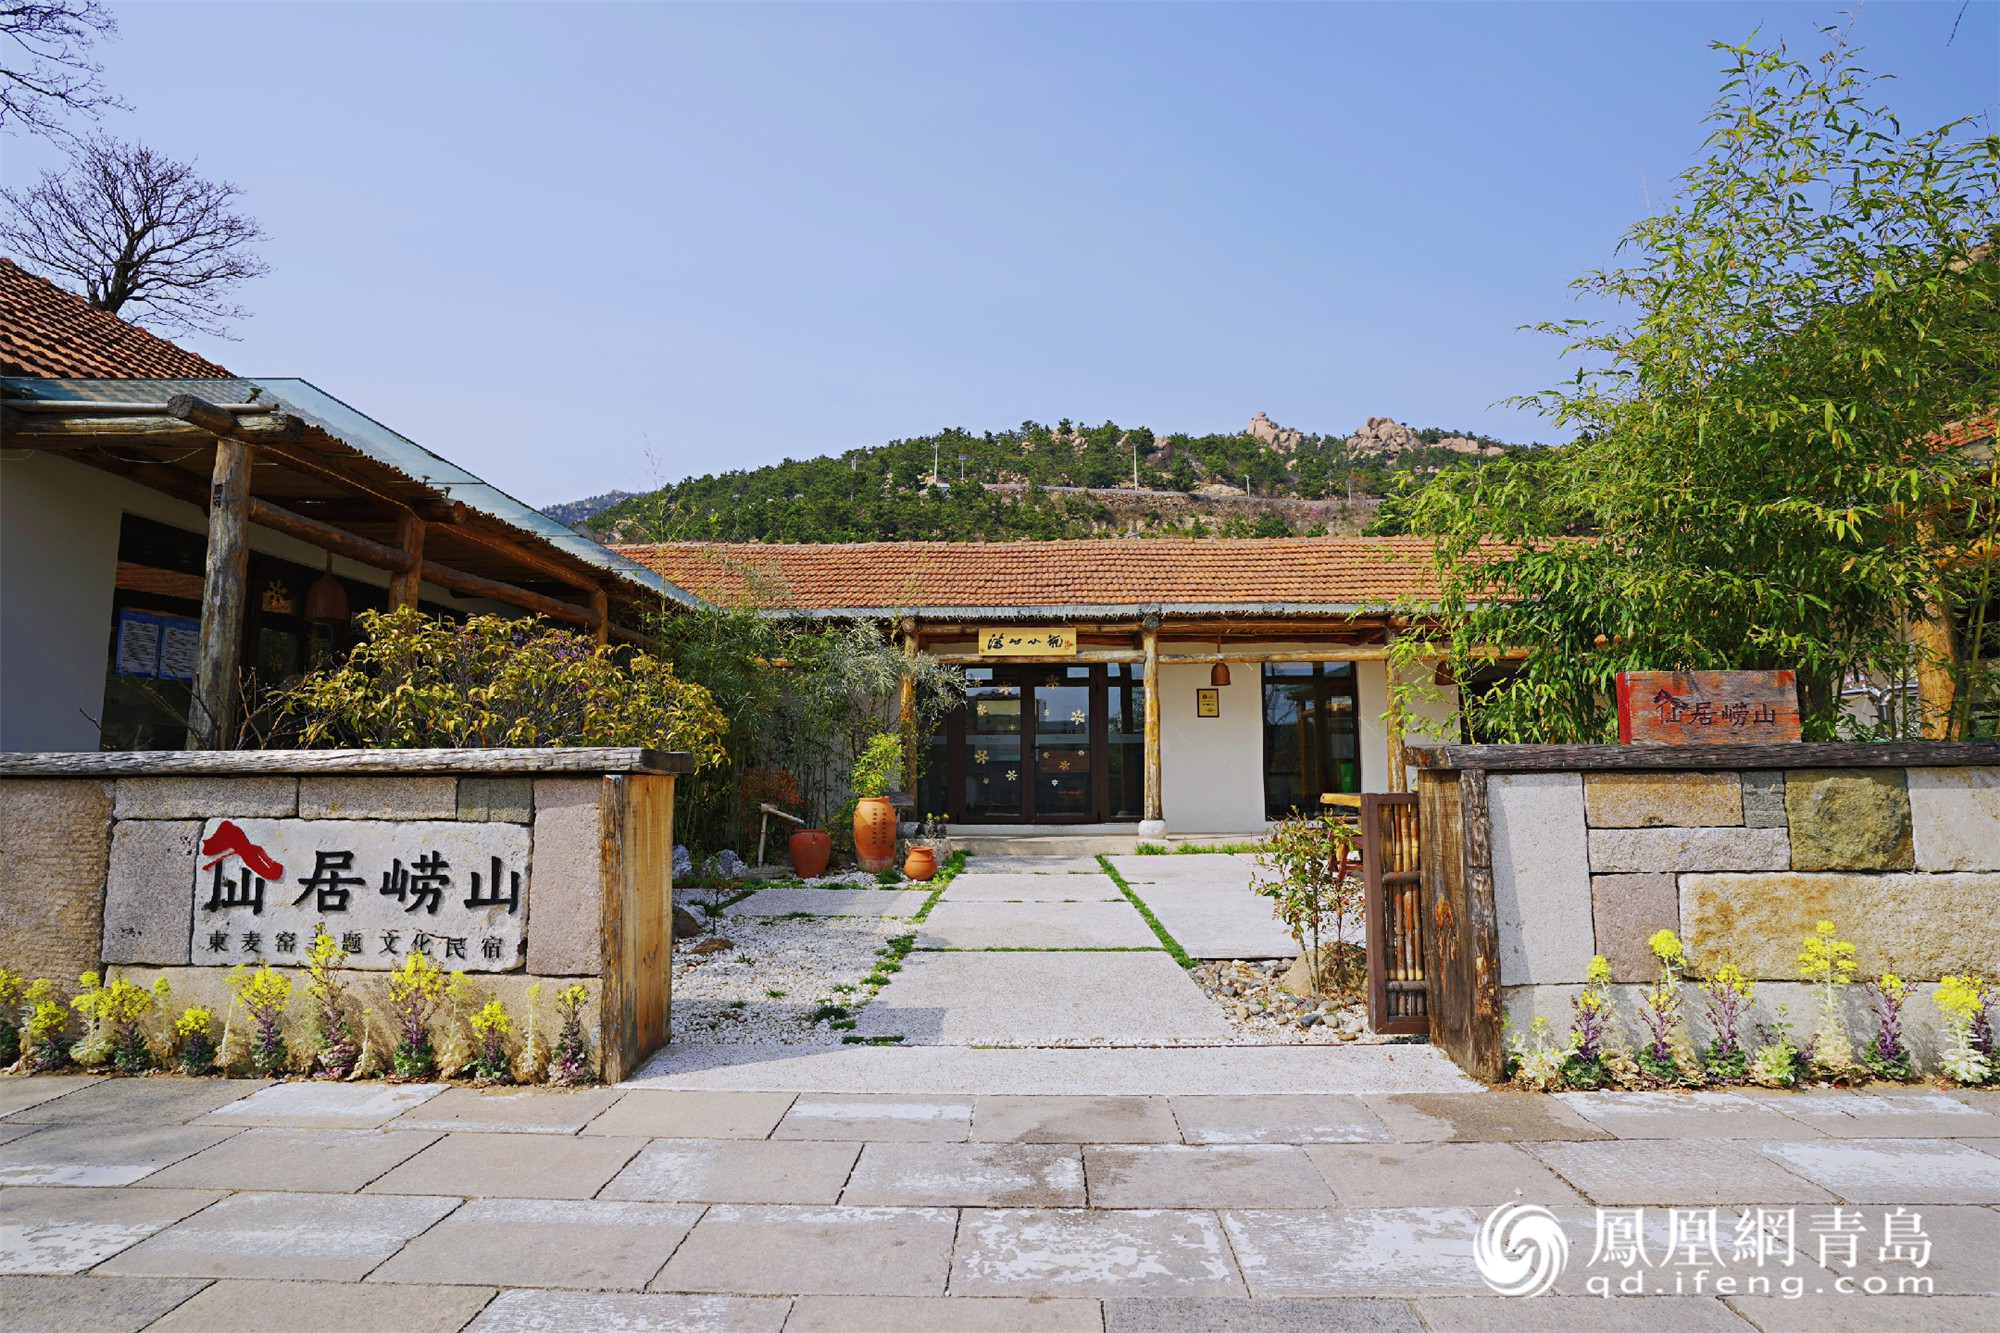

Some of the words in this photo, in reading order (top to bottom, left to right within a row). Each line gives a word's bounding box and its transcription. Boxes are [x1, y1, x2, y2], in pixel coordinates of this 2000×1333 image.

[1653, 688, 1776, 727] 仙居崂山
[202, 819, 520, 916] 仙居崂山
